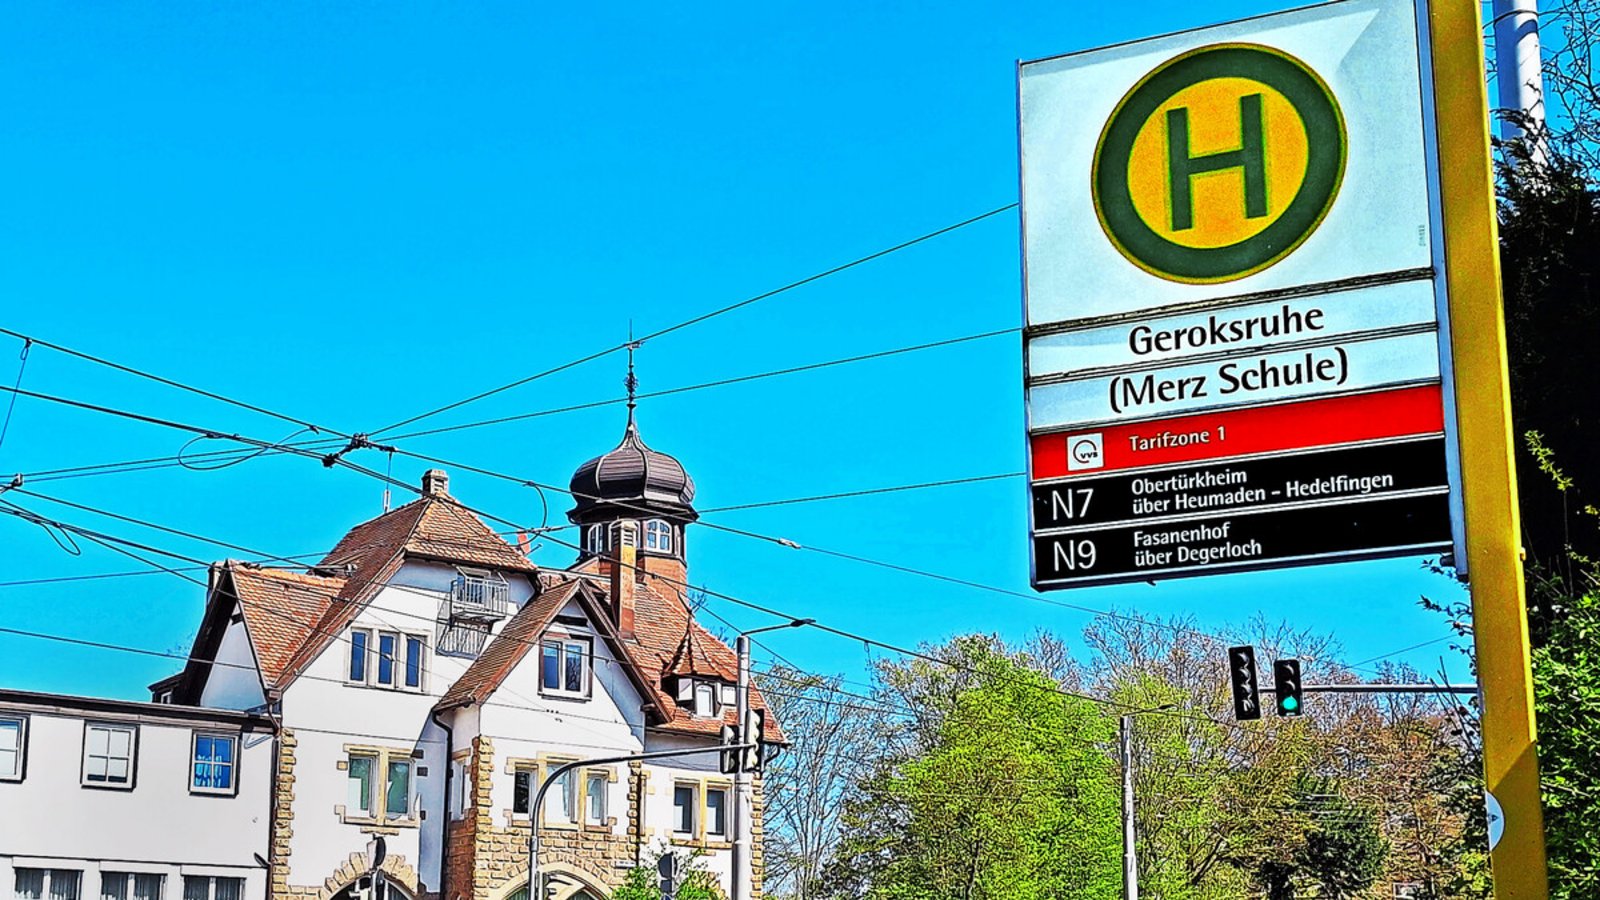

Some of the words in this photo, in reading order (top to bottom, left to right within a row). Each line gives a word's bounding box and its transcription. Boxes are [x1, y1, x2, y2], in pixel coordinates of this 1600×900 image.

[1167, 93, 1268, 232] H
[1129, 305, 1324, 355] Geroksruhe
[1110, 375, 1207, 413] (Merz
[1218, 347, 1348, 395] Schule)
[1129, 430, 1210, 451] Tarifzone
[1217, 426, 1226, 441] 1
[1131, 468, 1248, 495] Obertürkheim
[1132, 496, 1170, 515] über
[1175, 487, 1266, 510] Heumaden
[1286, 474, 1393, 498] Hedelfingen
[1051, 488, 1094, 520] N7
[1134, 521, 1231, 547] Fasanenhof
[1053, 539, 1097, 571] N9
[1135, 548, 1173, 567] über
[1177, 539, 1262, 564] Degerloch
